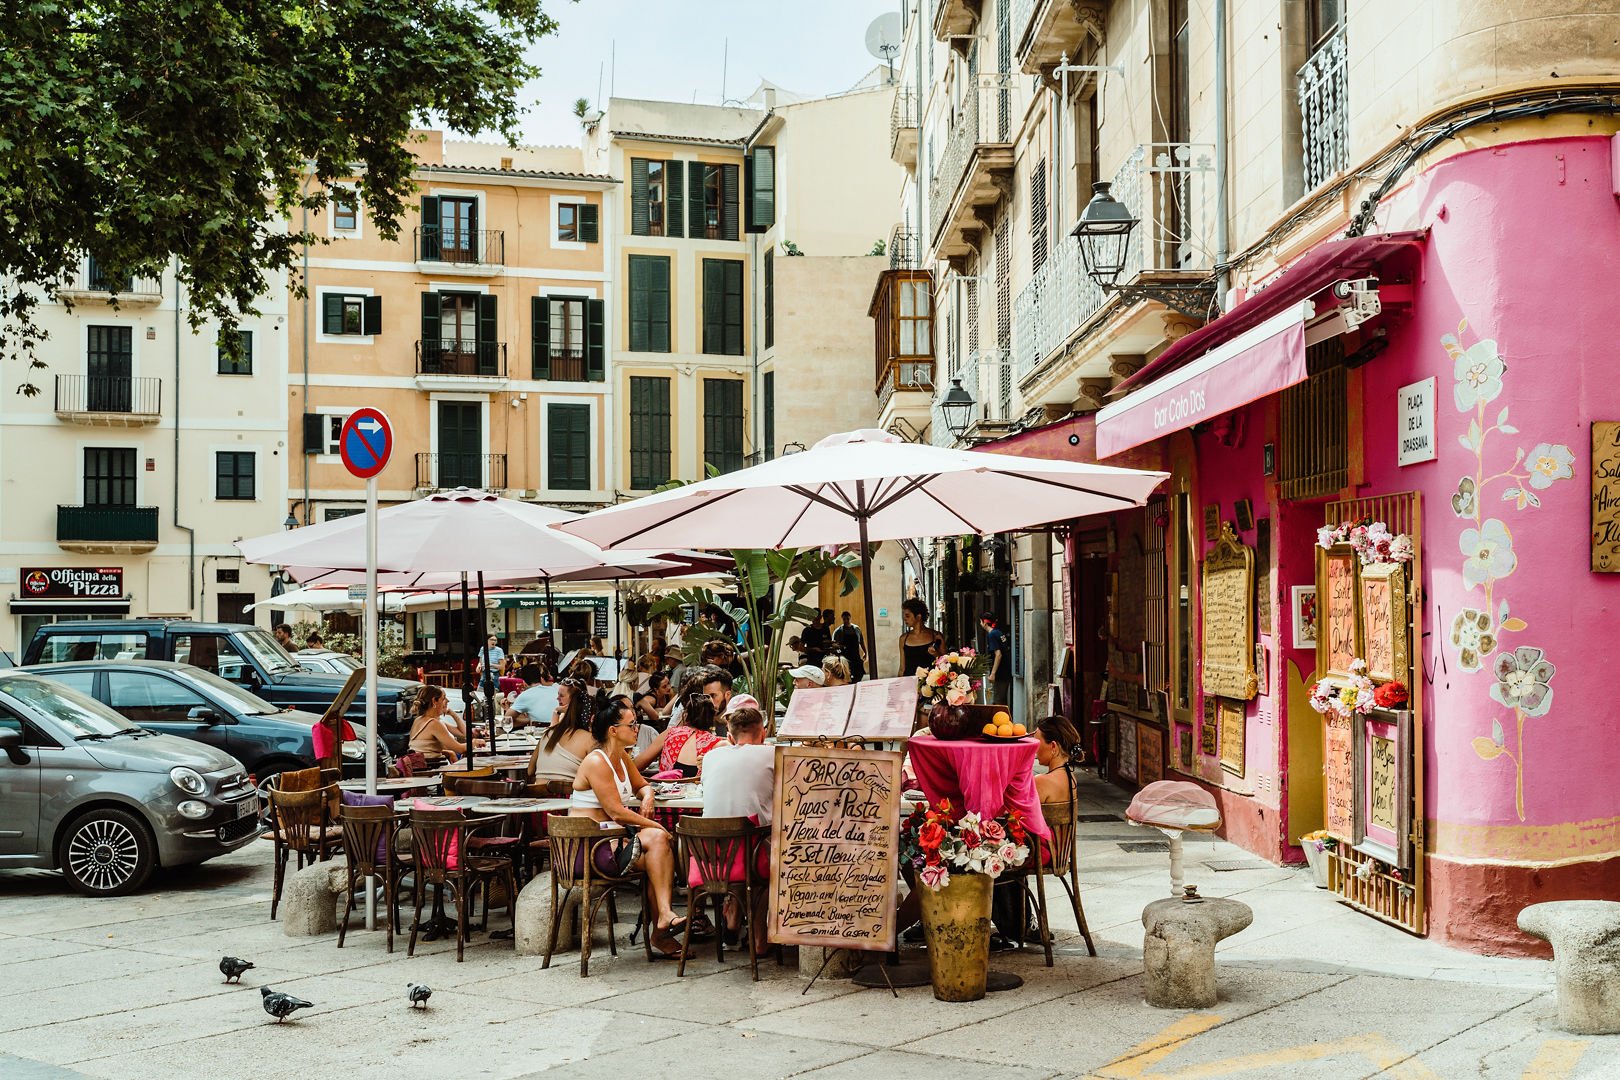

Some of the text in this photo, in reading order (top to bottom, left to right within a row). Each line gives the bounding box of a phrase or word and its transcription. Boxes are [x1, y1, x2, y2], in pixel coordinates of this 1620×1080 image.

[1154, 389, 1205, 429] bar Coto Dos
[1407, 393, 1424, 411] PLAÇA
[1408, 415, 1422, 431] DE LA
[1402, 435, 1428, 453] DRASSANA
[51, 569, 100, 584] Officina
[68, 581, 120, 595] Pizza
[803, 759, 866, 786] BAR Coto
[839, 787, 882, 819] Pasta
[821, 820, 842, 840] del
